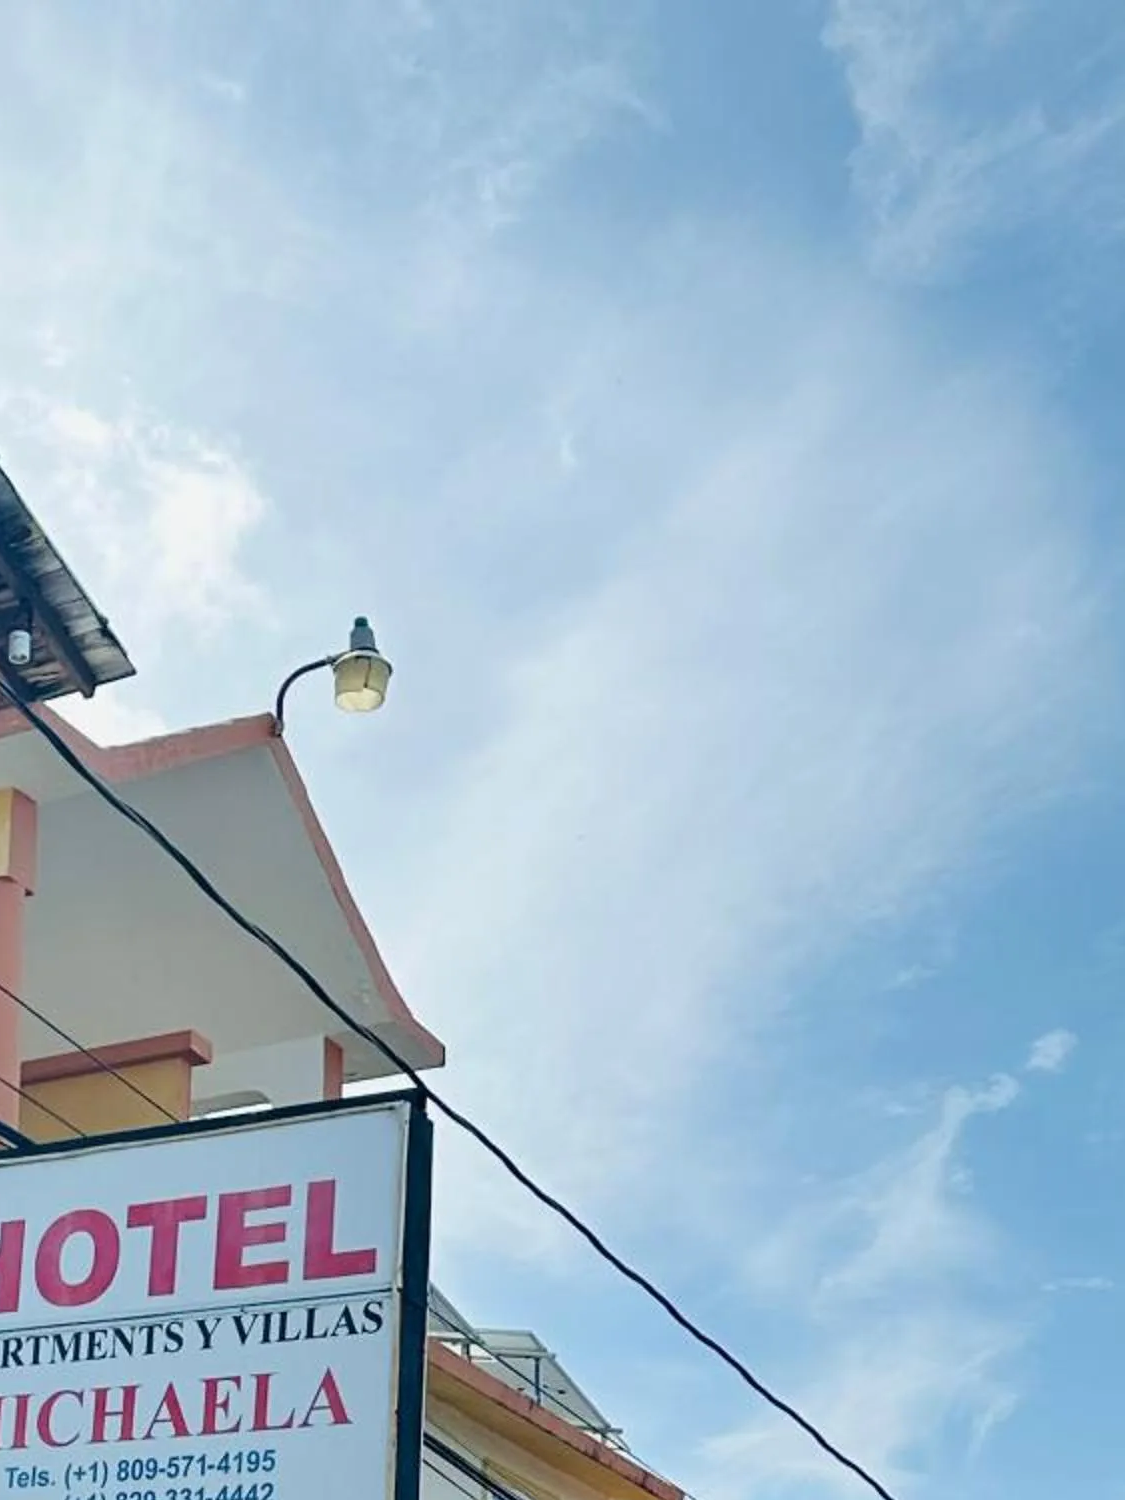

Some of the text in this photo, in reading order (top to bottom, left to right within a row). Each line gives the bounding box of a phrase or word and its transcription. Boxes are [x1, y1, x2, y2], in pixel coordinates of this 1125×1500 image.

[195, 1317, 223, 1350] Y
[231, 1300, 385, 1346] VILLAS
[5, 1450, 276, 1490] Tels. (+1) 809-571-4195
